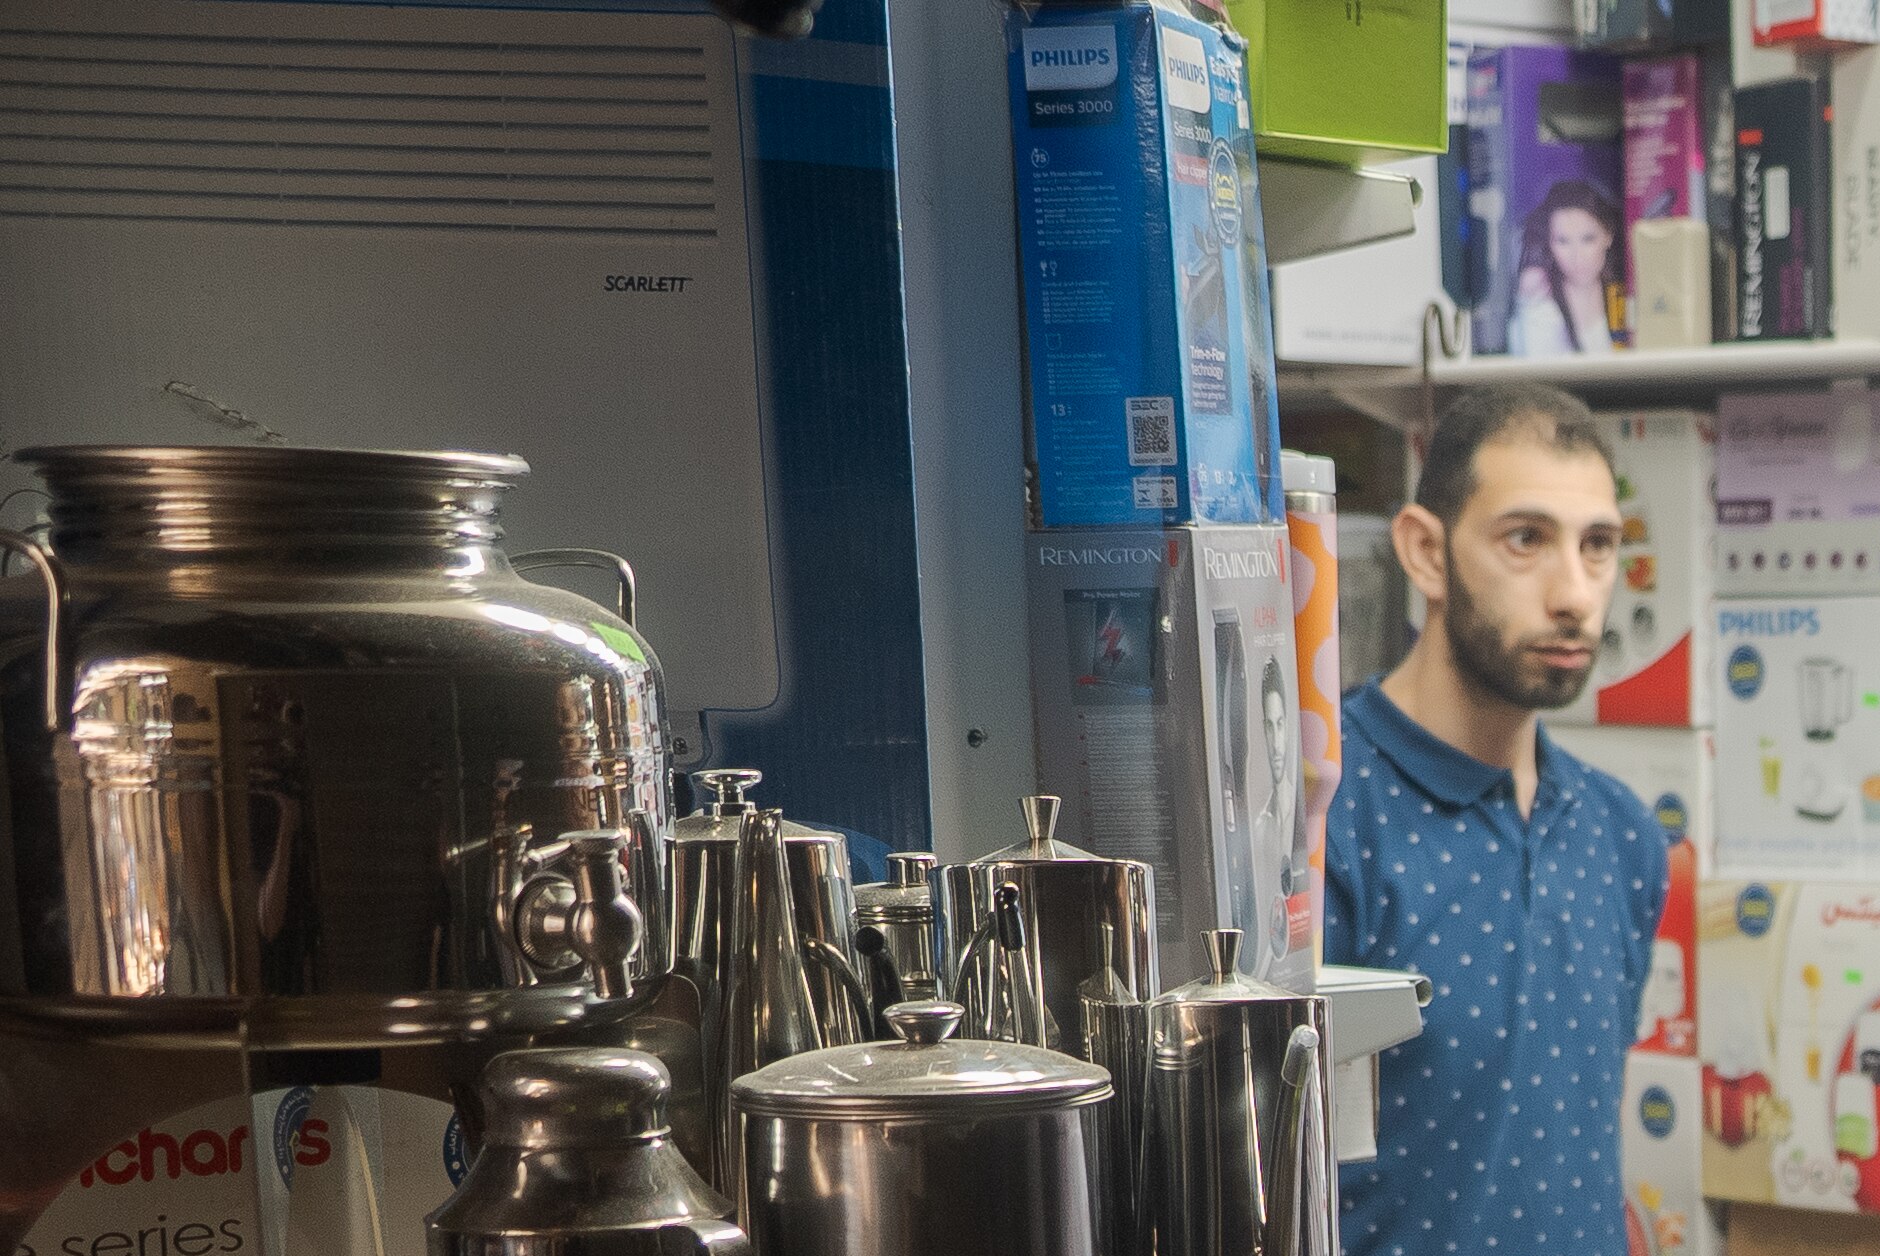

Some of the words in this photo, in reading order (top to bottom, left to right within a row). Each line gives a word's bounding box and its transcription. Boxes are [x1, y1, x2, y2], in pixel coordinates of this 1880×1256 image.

[1031, 48, 1110, 67] PHILIPS
[1169, 56, 1206, 86] PHILIPS
[1035, 101, 1075, 115] Series
[1077, 100, 1114, 114] 3000
[1174, 122, 1194, 140] Series
[1195, 127, 1211, 144] 3000
[1034, 153, 1047, 163] 75
[604, 275, 693, 293] SCARLETT
[1191, 363, 1224, 381] technology
[1040, 546, 1162, 567] REMINGTON
[1204, 547, 1279, 580] REMINGTON
[1718, 607, 1821, 636] PHILIPS
